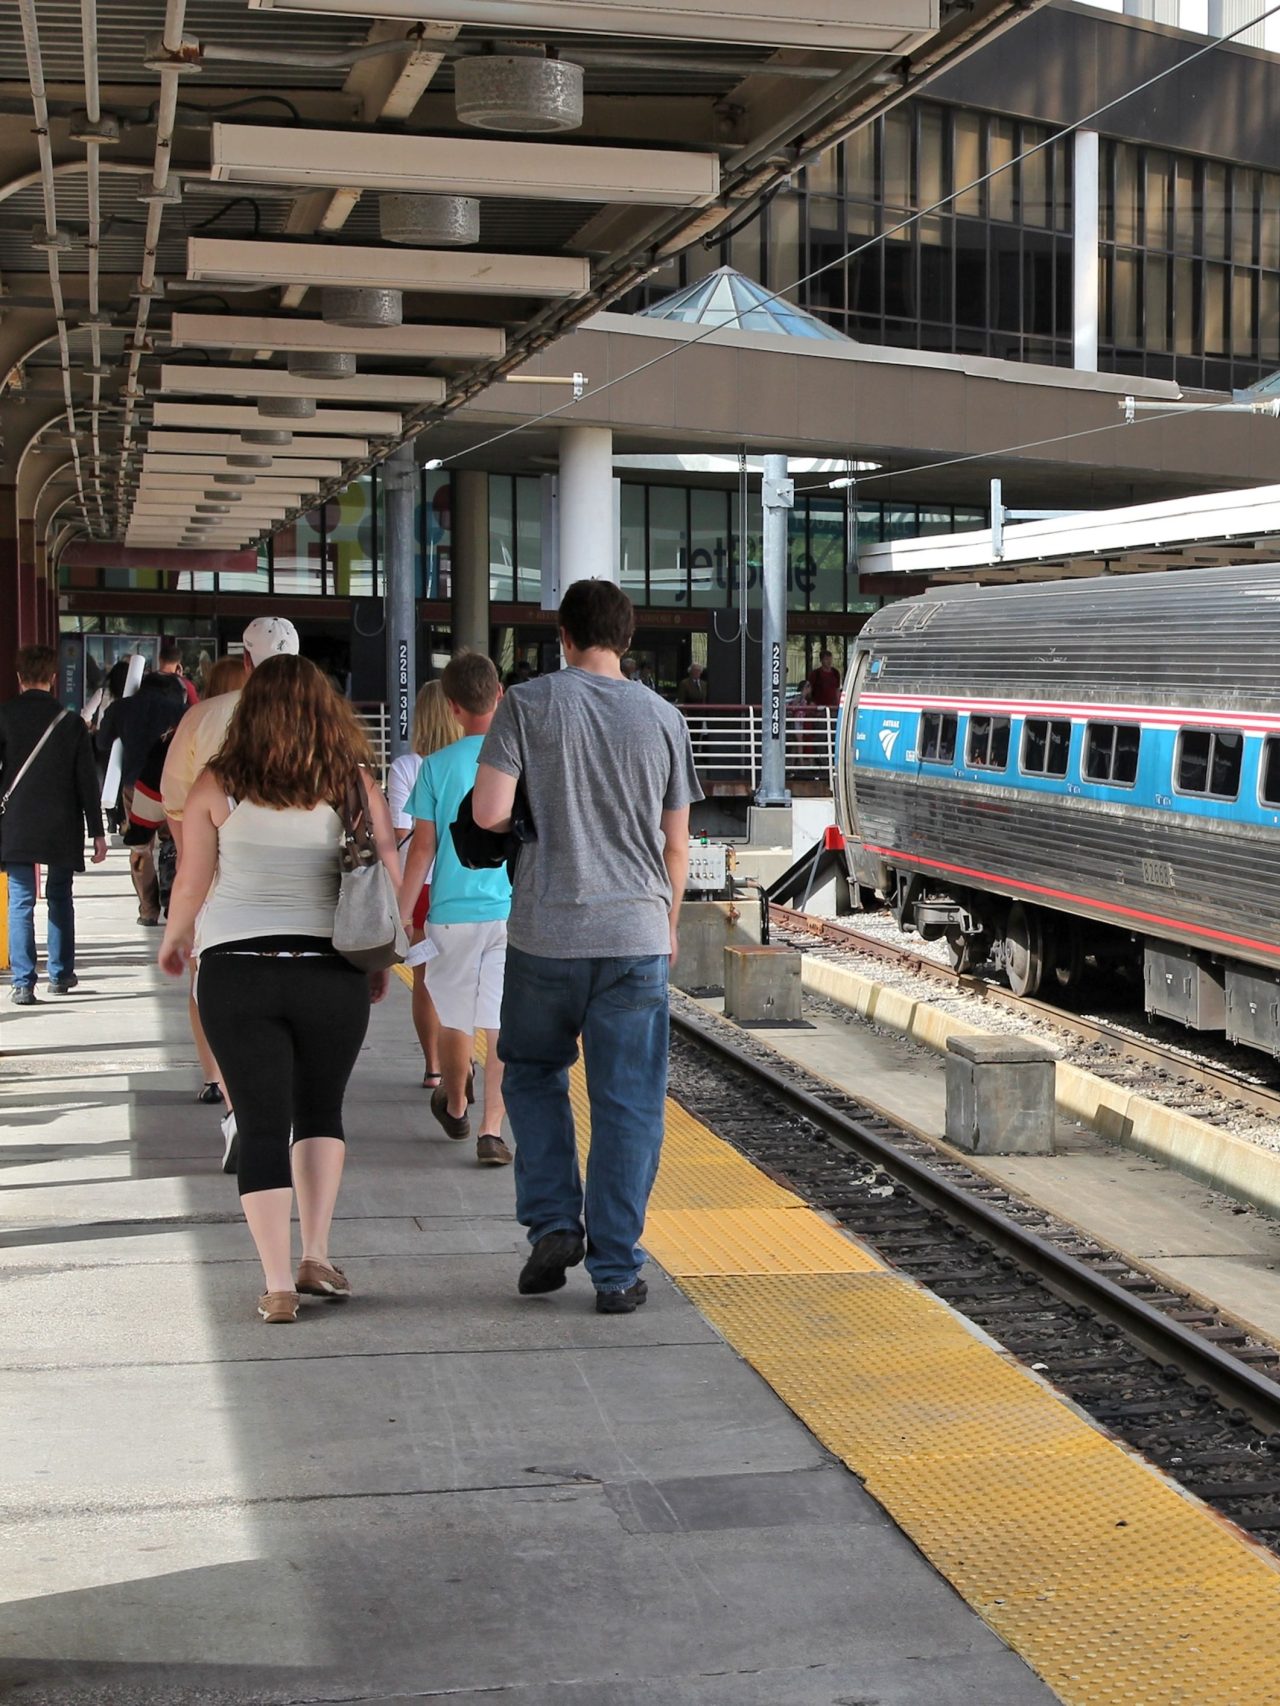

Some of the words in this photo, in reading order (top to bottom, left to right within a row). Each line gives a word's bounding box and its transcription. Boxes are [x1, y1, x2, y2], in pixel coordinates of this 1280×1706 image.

[674, 531, 817, 603] jetBle
[66, 664, 76, 693] Taxis
[400, 645, 408, 735] 228-347
[772, 645, 780, 734] 228-348
